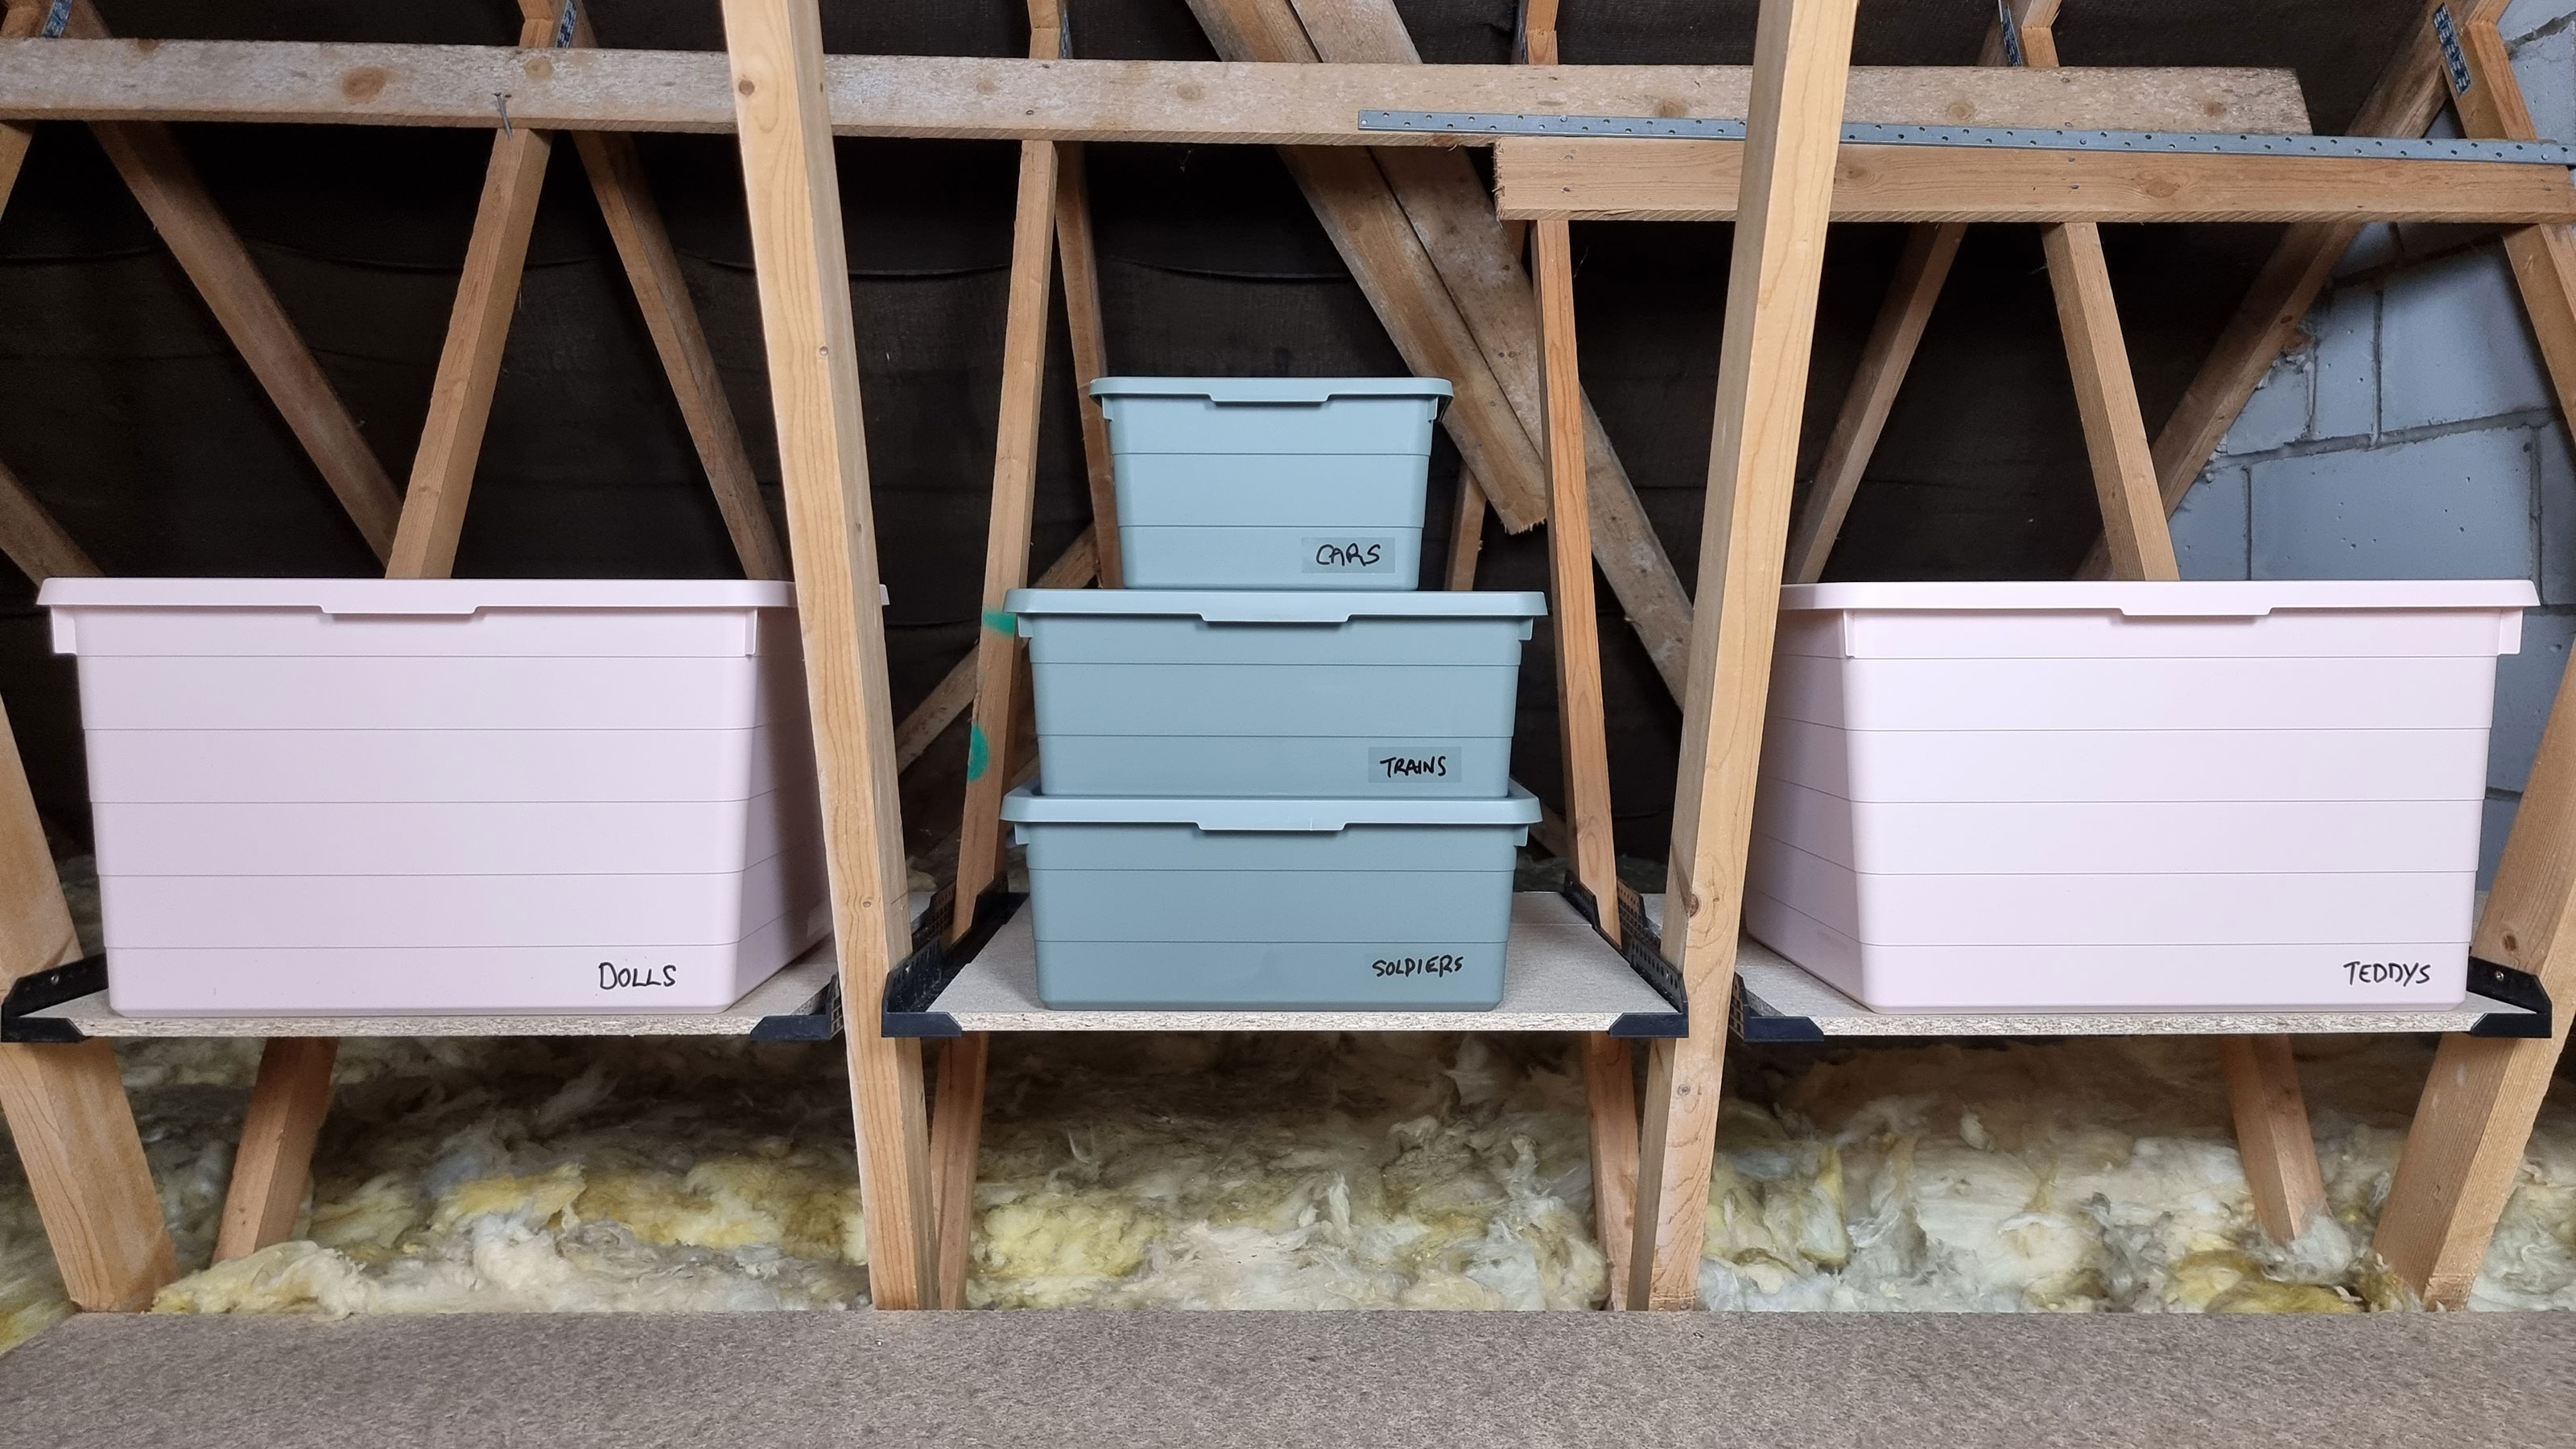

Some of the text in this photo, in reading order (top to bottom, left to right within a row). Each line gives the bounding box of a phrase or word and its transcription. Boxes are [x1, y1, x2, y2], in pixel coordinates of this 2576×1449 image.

[1315, 543, 1381, 568] CARS
[1379, 755, 1447, 778] TRAINS
[598, 962, 676, 990] DOLLS
[1372, 954, 1464, 978] SOLDIERS
[2343, 961, 2430, 987] TEDDYS
